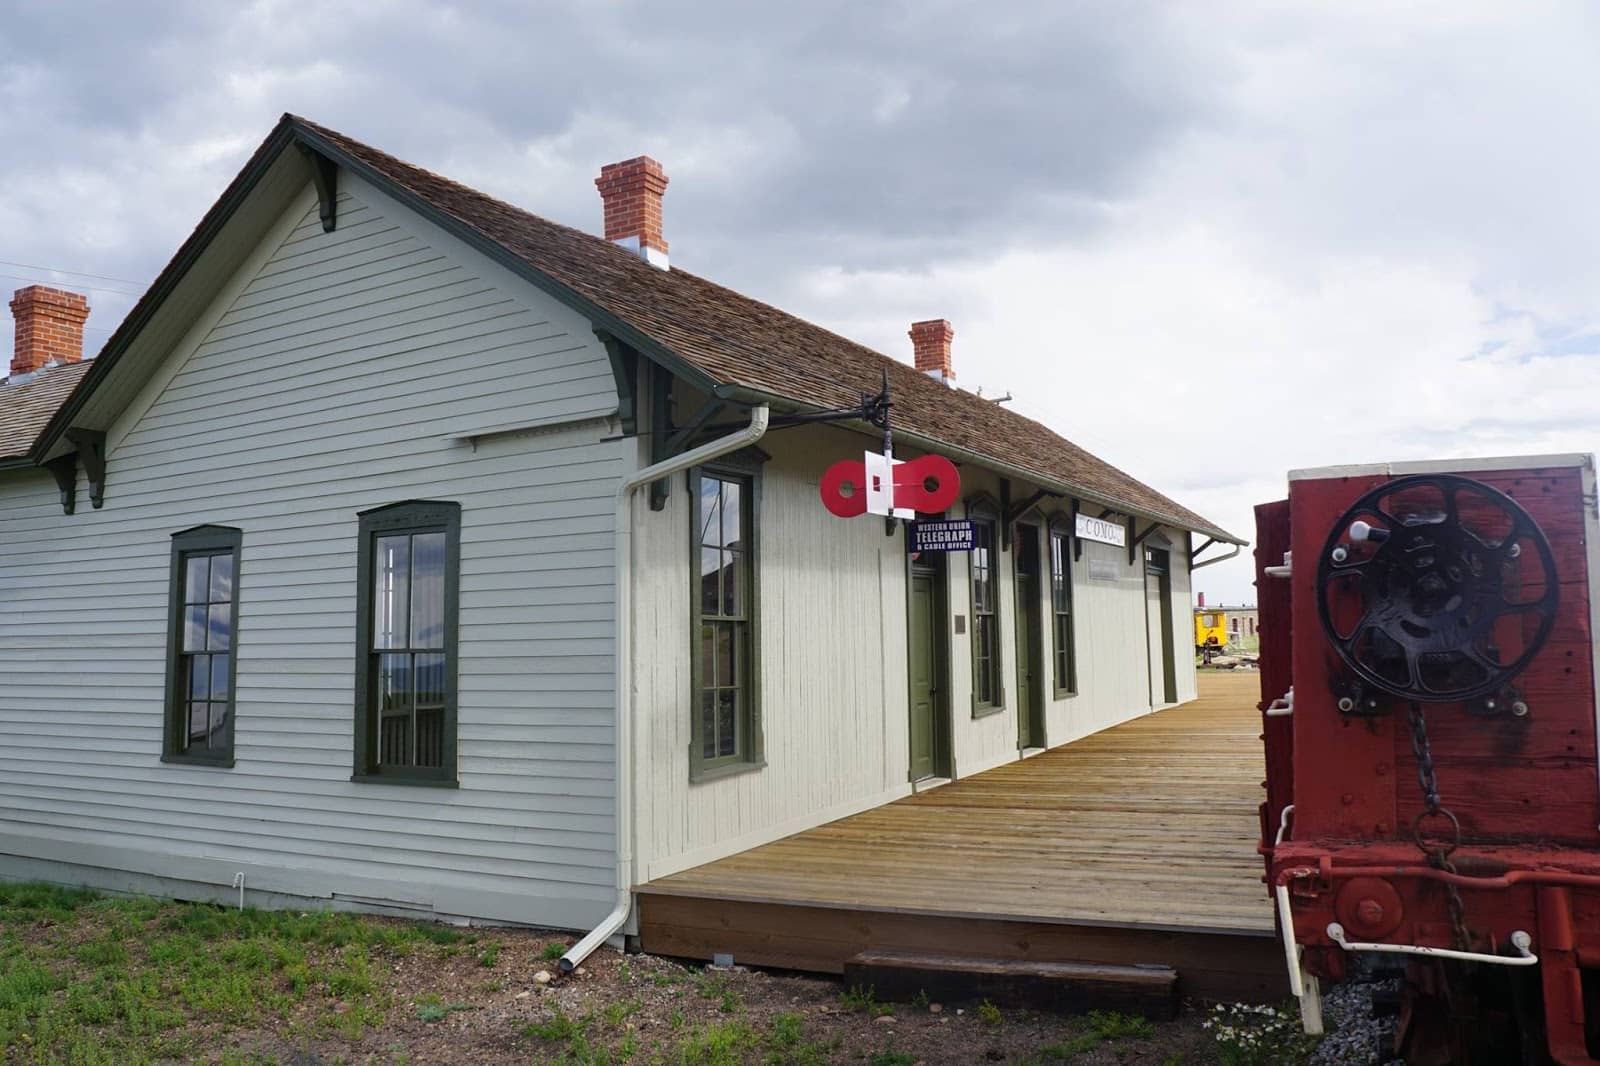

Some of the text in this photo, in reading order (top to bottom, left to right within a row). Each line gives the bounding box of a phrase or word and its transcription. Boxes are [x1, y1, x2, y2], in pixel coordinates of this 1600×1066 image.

[917, 522, 970, 531] WESTERN UNION
[916, 530, 972, 543] TELEGRAPH
